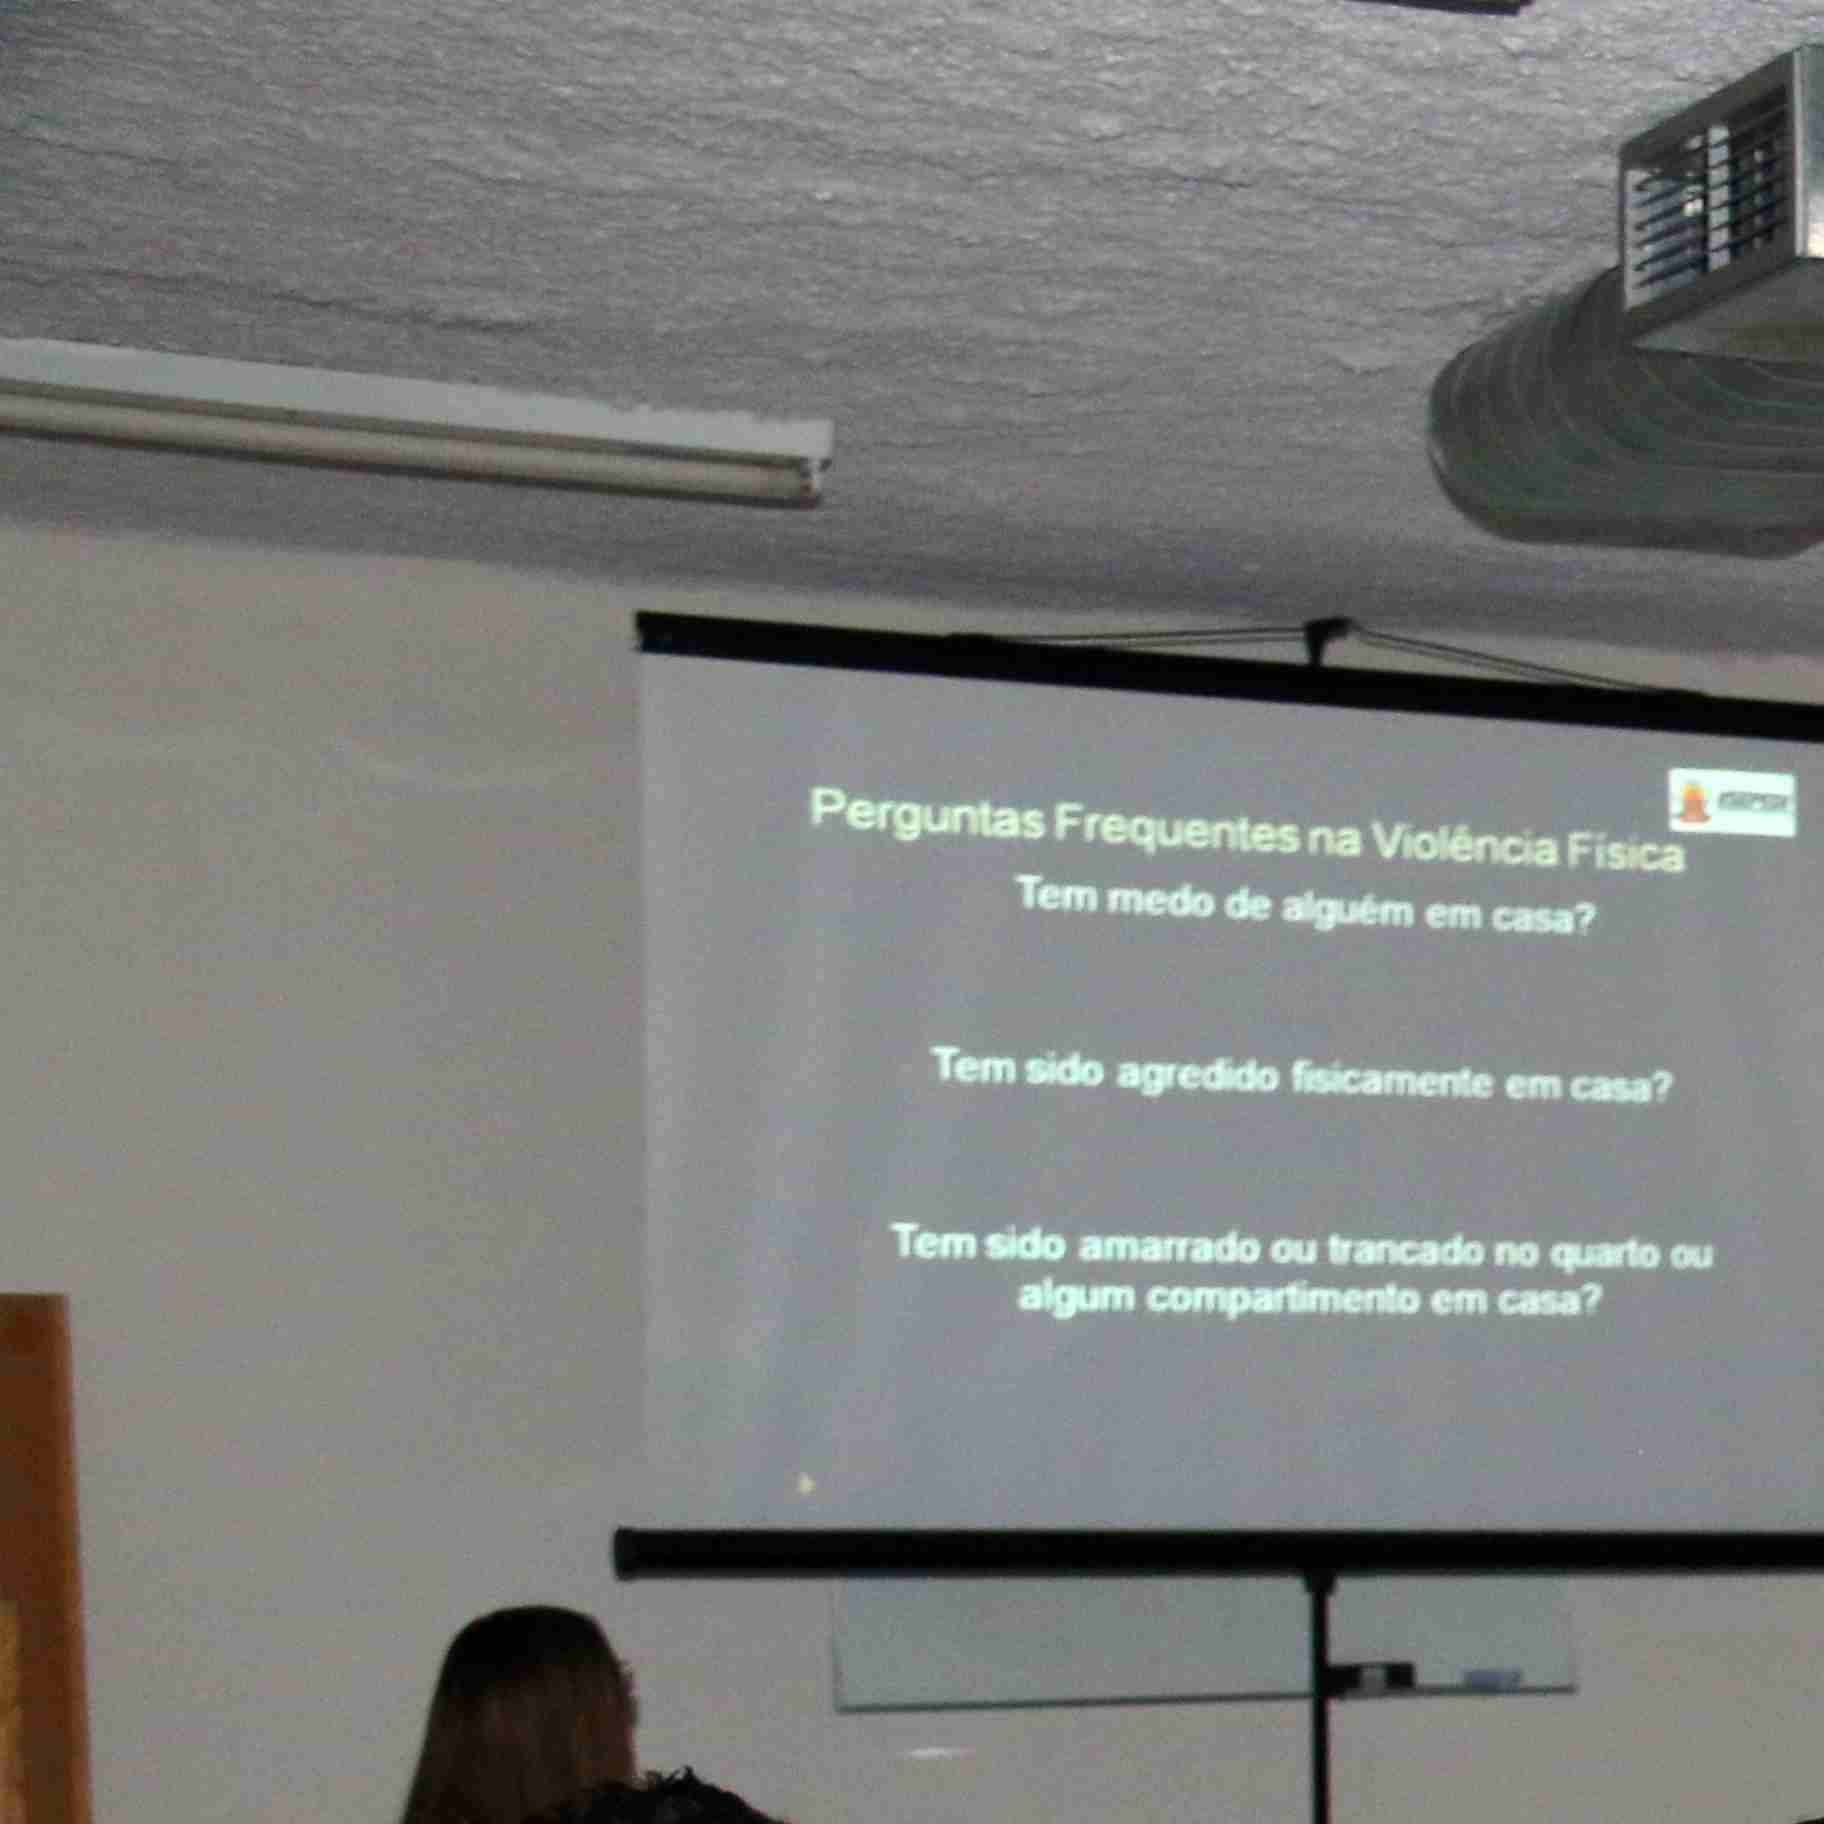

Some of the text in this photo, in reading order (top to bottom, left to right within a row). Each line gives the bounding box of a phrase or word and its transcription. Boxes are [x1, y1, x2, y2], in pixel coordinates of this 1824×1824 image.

[809, 785, 1047, 841] Perguntas
[1054, 801, 1301, 854] Frequentes
[1308, 826, 1362, 857] na
[1371, 820, 1560, 867] Violência
[1014, 874, 1599, 935] Tem medo de alguém em casa?
[930, 1043, 1017, 1085] Tem
[1024, 1051, 1105, 1086] sido
[1116, 1057, 1279, 1097] agredido
[1505, 1074, 1562, 1100] em
[1572, 1071, 1674, 1103] casa?
[889, 1222, 1714, 1273] Tem sido amarrado ou trancado no quarto ou
[1017, 1278, 1602, 1321] algum compartimento em casa?
